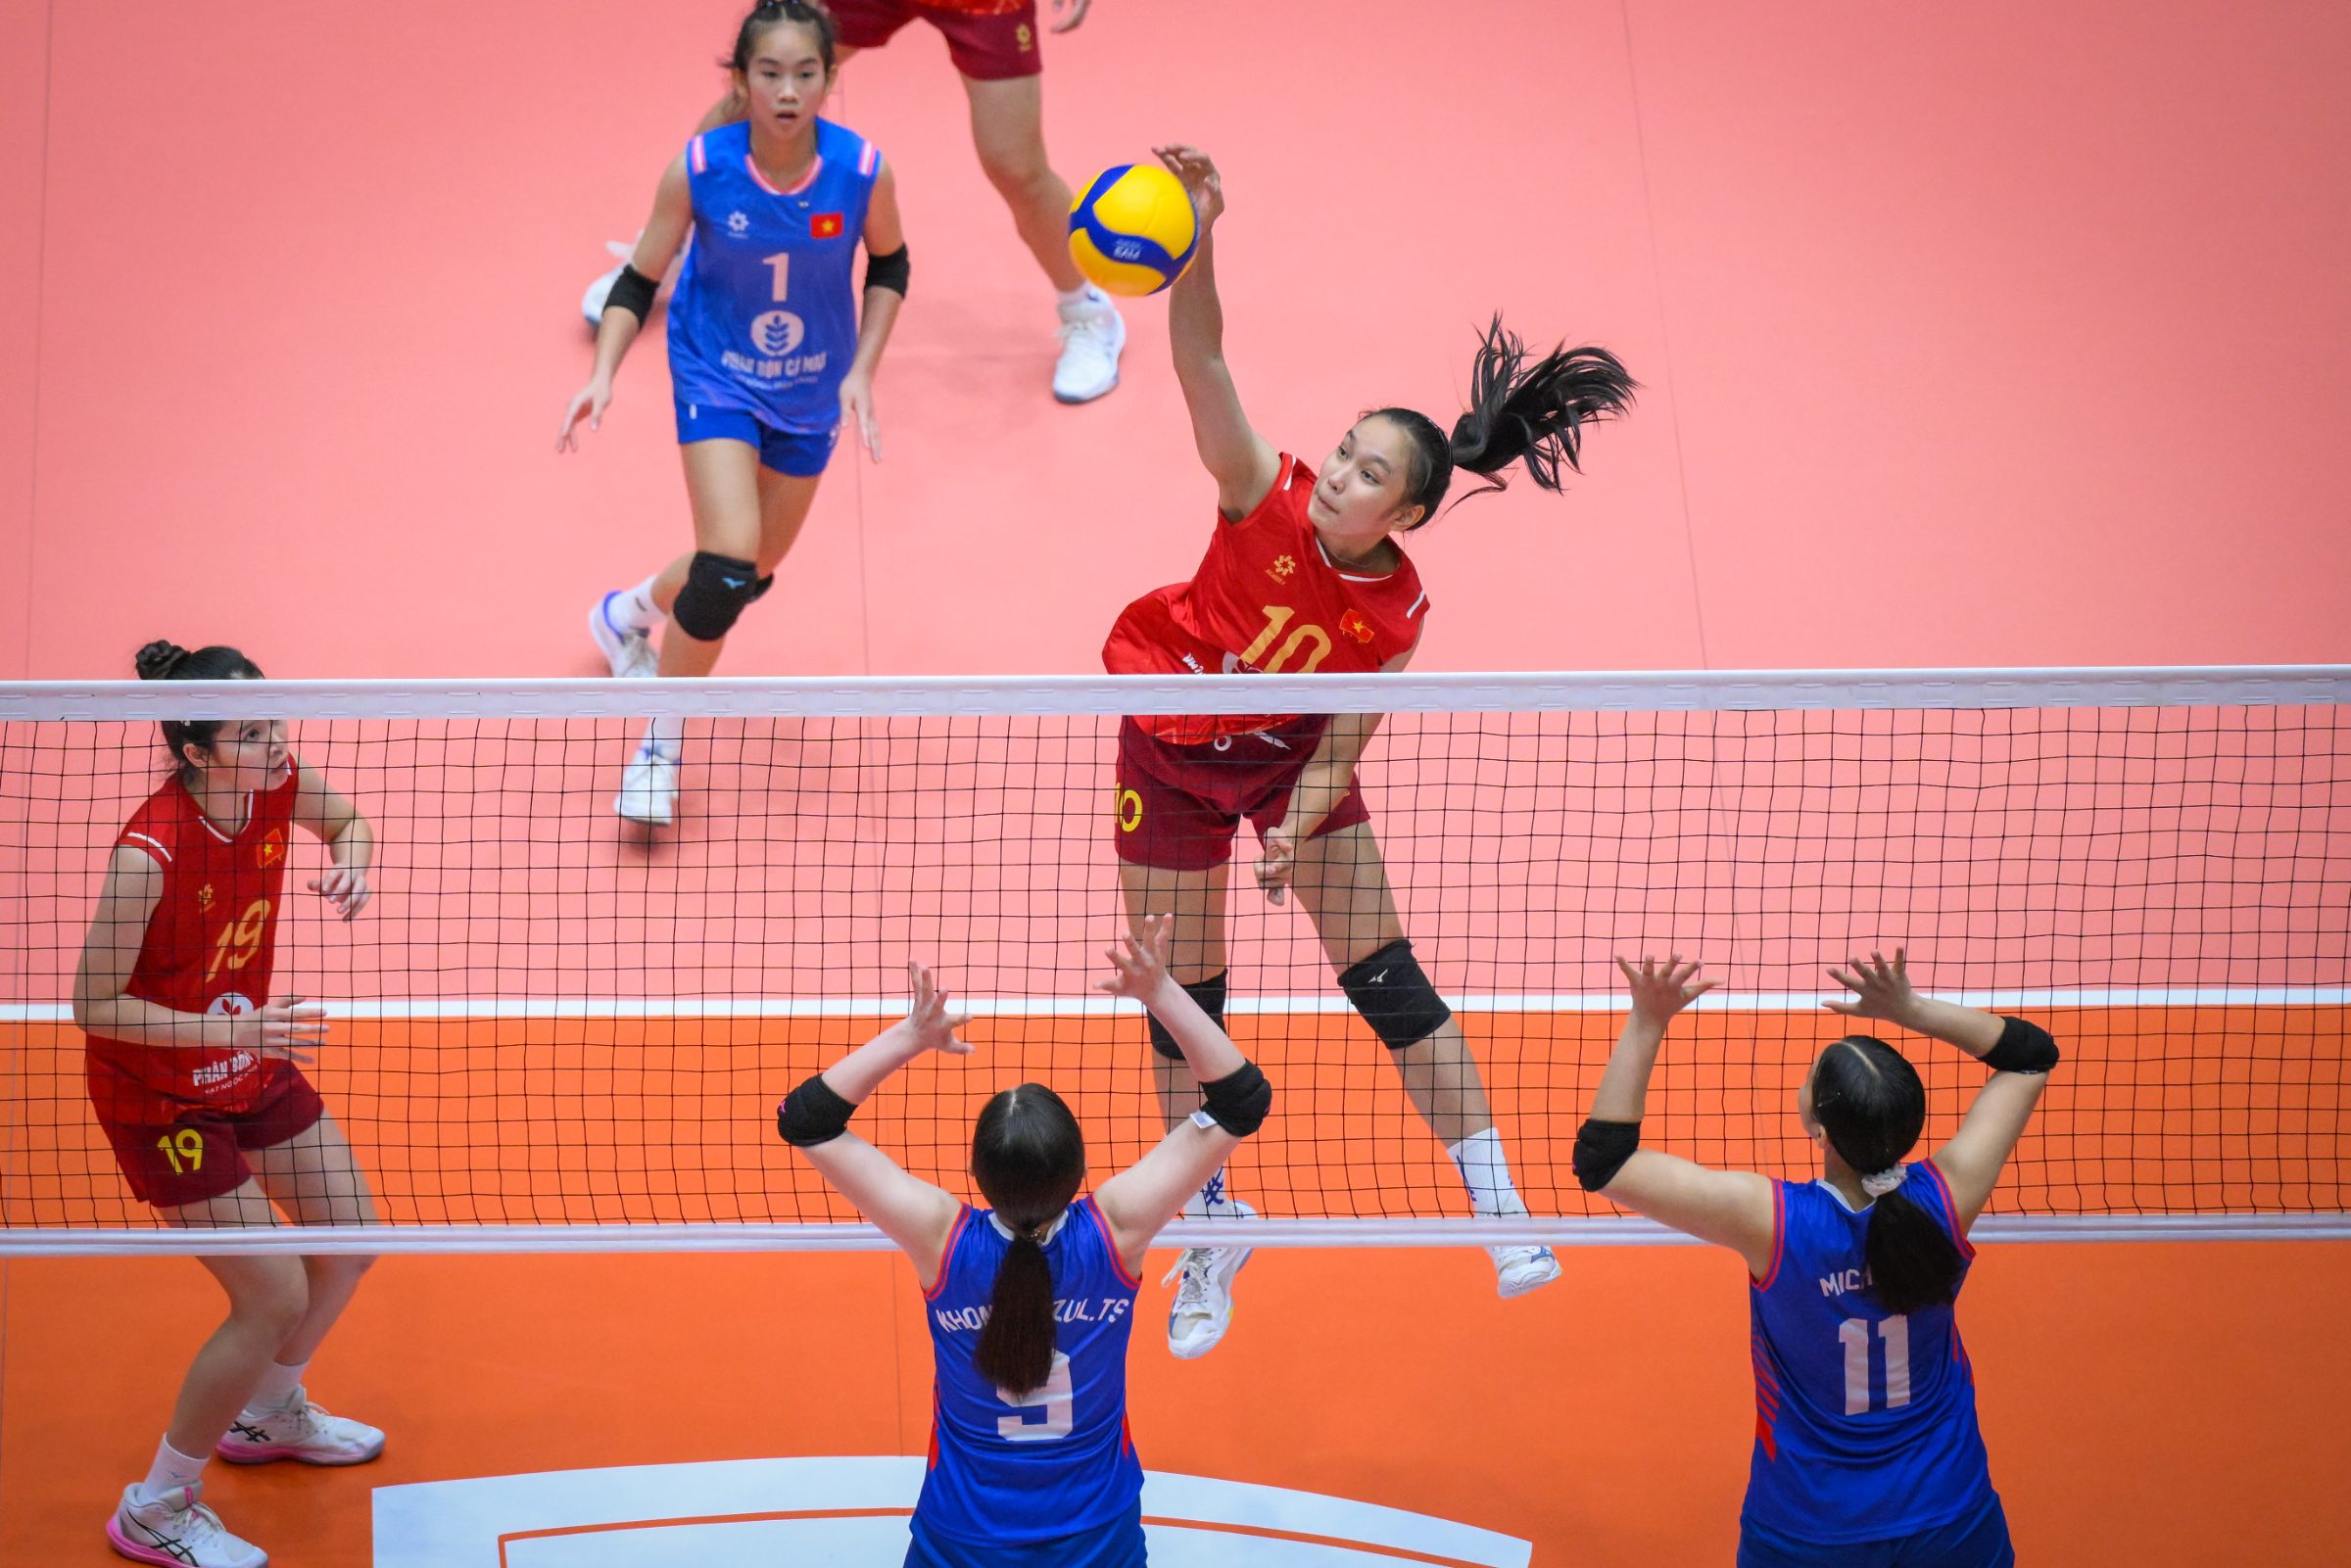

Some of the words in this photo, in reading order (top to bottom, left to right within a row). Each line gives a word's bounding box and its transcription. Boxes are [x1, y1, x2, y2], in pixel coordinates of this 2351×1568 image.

[762, 252, 790, 303] 1
[1238, 604, 1332, 675] 10
[206, 899, 270, 983] 19
[157, 1128, 204, 1175] 19
[995, 1348, 1074, 1442] 9
[1838, 1314, 1911, 1416] 11
